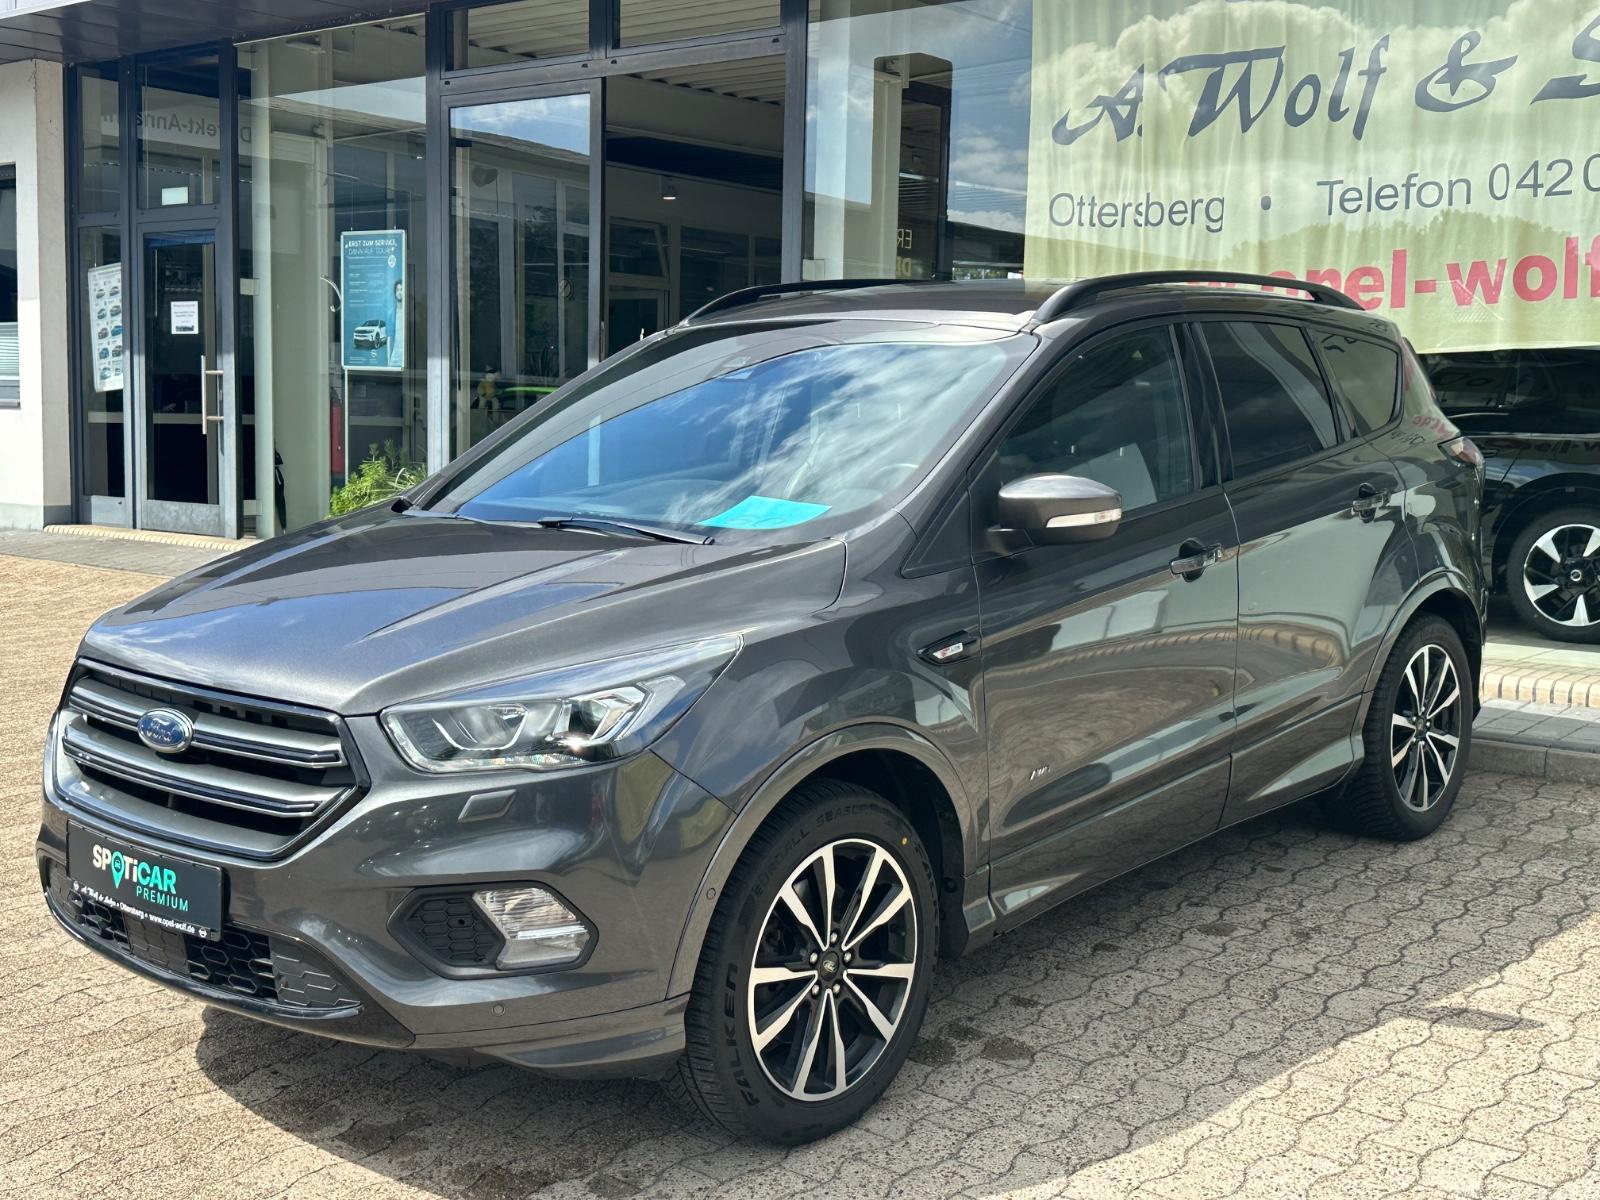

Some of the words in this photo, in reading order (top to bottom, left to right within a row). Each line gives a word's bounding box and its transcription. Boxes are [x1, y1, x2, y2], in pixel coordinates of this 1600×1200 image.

[1158, 34, 1389, 141] Wolf
[1415, 30, 1518, 113] &
[1050, 192, 1225, 233] Ottersberg
[1316, 173, 1472, 216] Telefon
[136, 885, 189, 912] PREMIUM
[724, 963, 760, 1107] FALKEN
